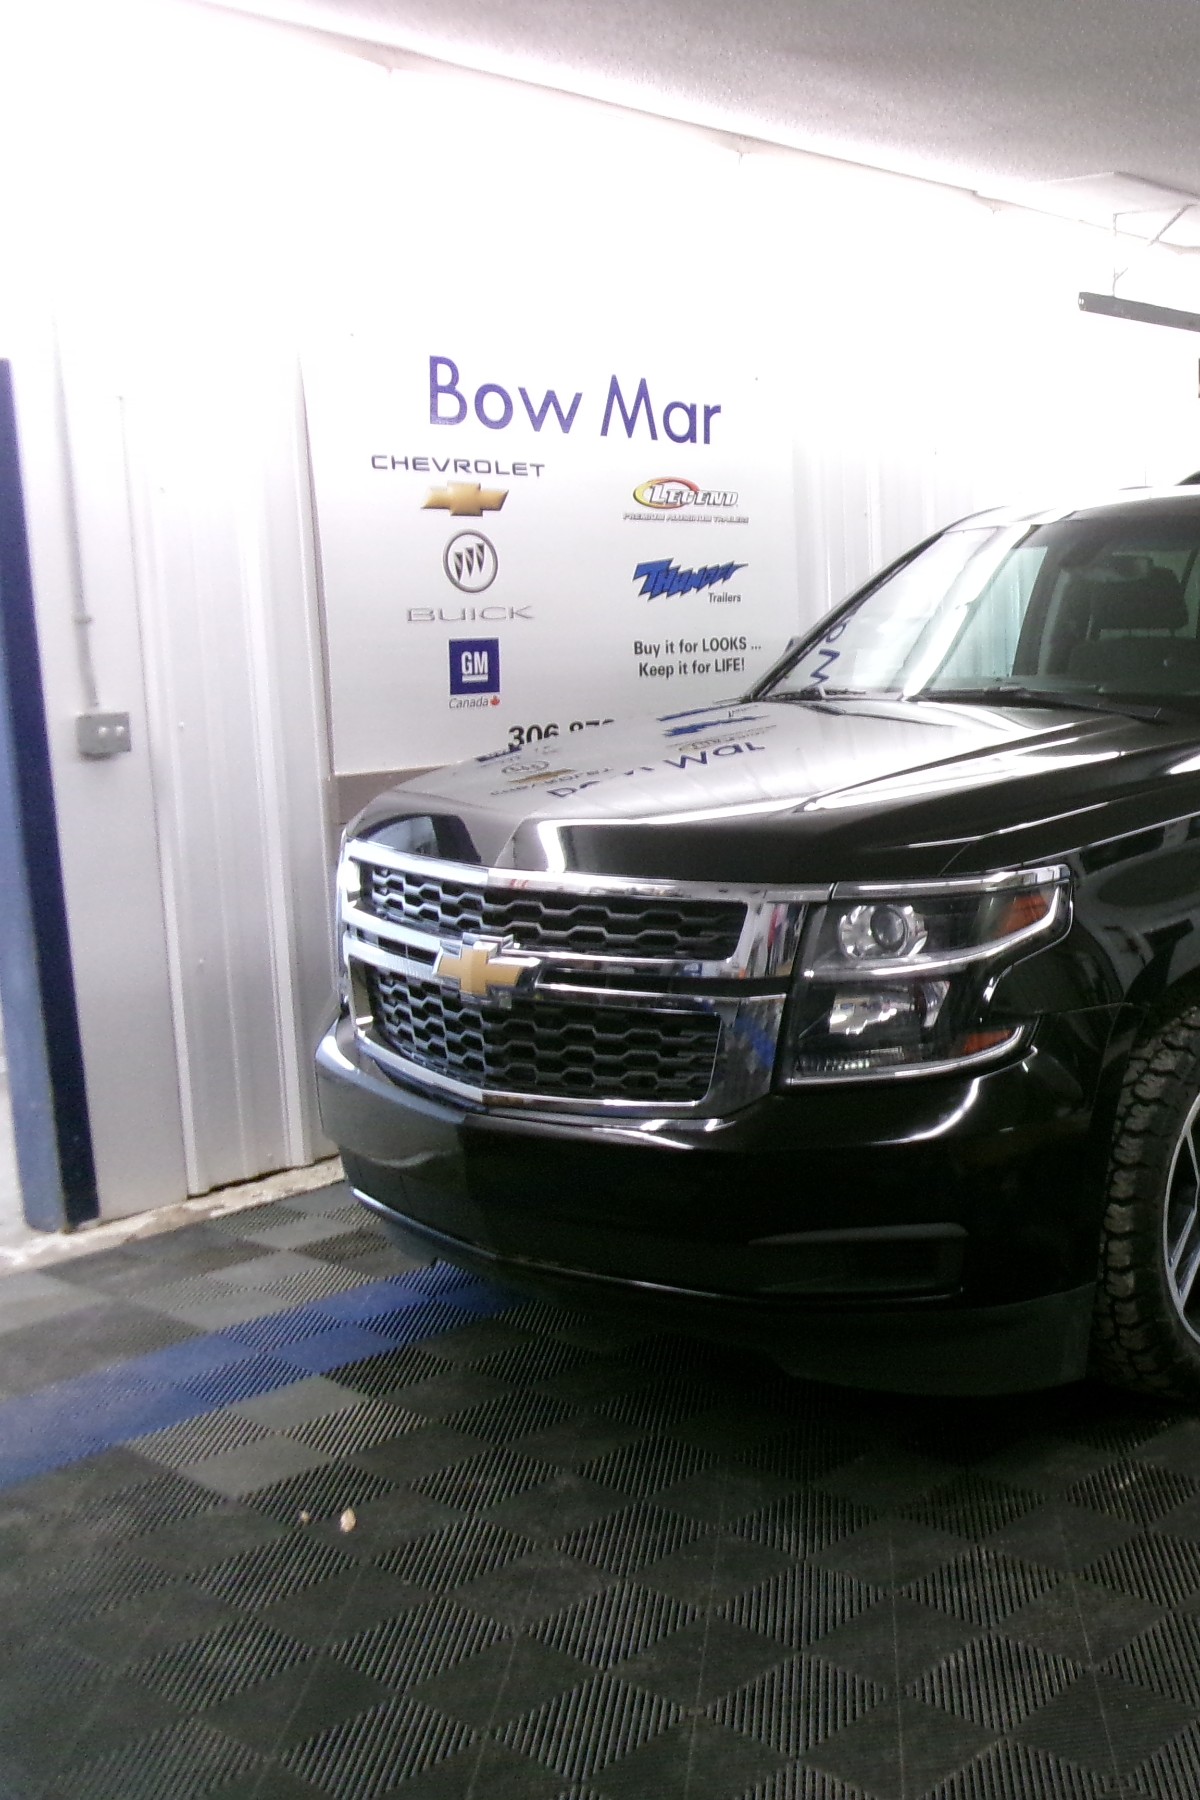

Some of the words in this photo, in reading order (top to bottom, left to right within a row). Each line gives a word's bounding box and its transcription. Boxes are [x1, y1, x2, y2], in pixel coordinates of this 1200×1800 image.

[429, 355, 583, 434] Bow
[600, 374, 722, 445] Mar
[371, 454, 546, 478] CHEVROLET
[648, 483, 739, 507] LEGEND
[708, 592, 742, 603] Trailers
[406, 605, 535, 622] BUICK
[634, 640, 661, 658] Buy
[665, 639, 675, 654] it
[679, 638, 699, 653] for
[702, 636, 747, 652] LOOKS
[461, 650, 489, 675] GM
[639, 661, 674, 679] Keep
[678, 660, 688, 675] it
[692, 659, 711, 675] for
[714, 657, 745, 673] LIFE!
[448, 696, 489, 709] Canada
